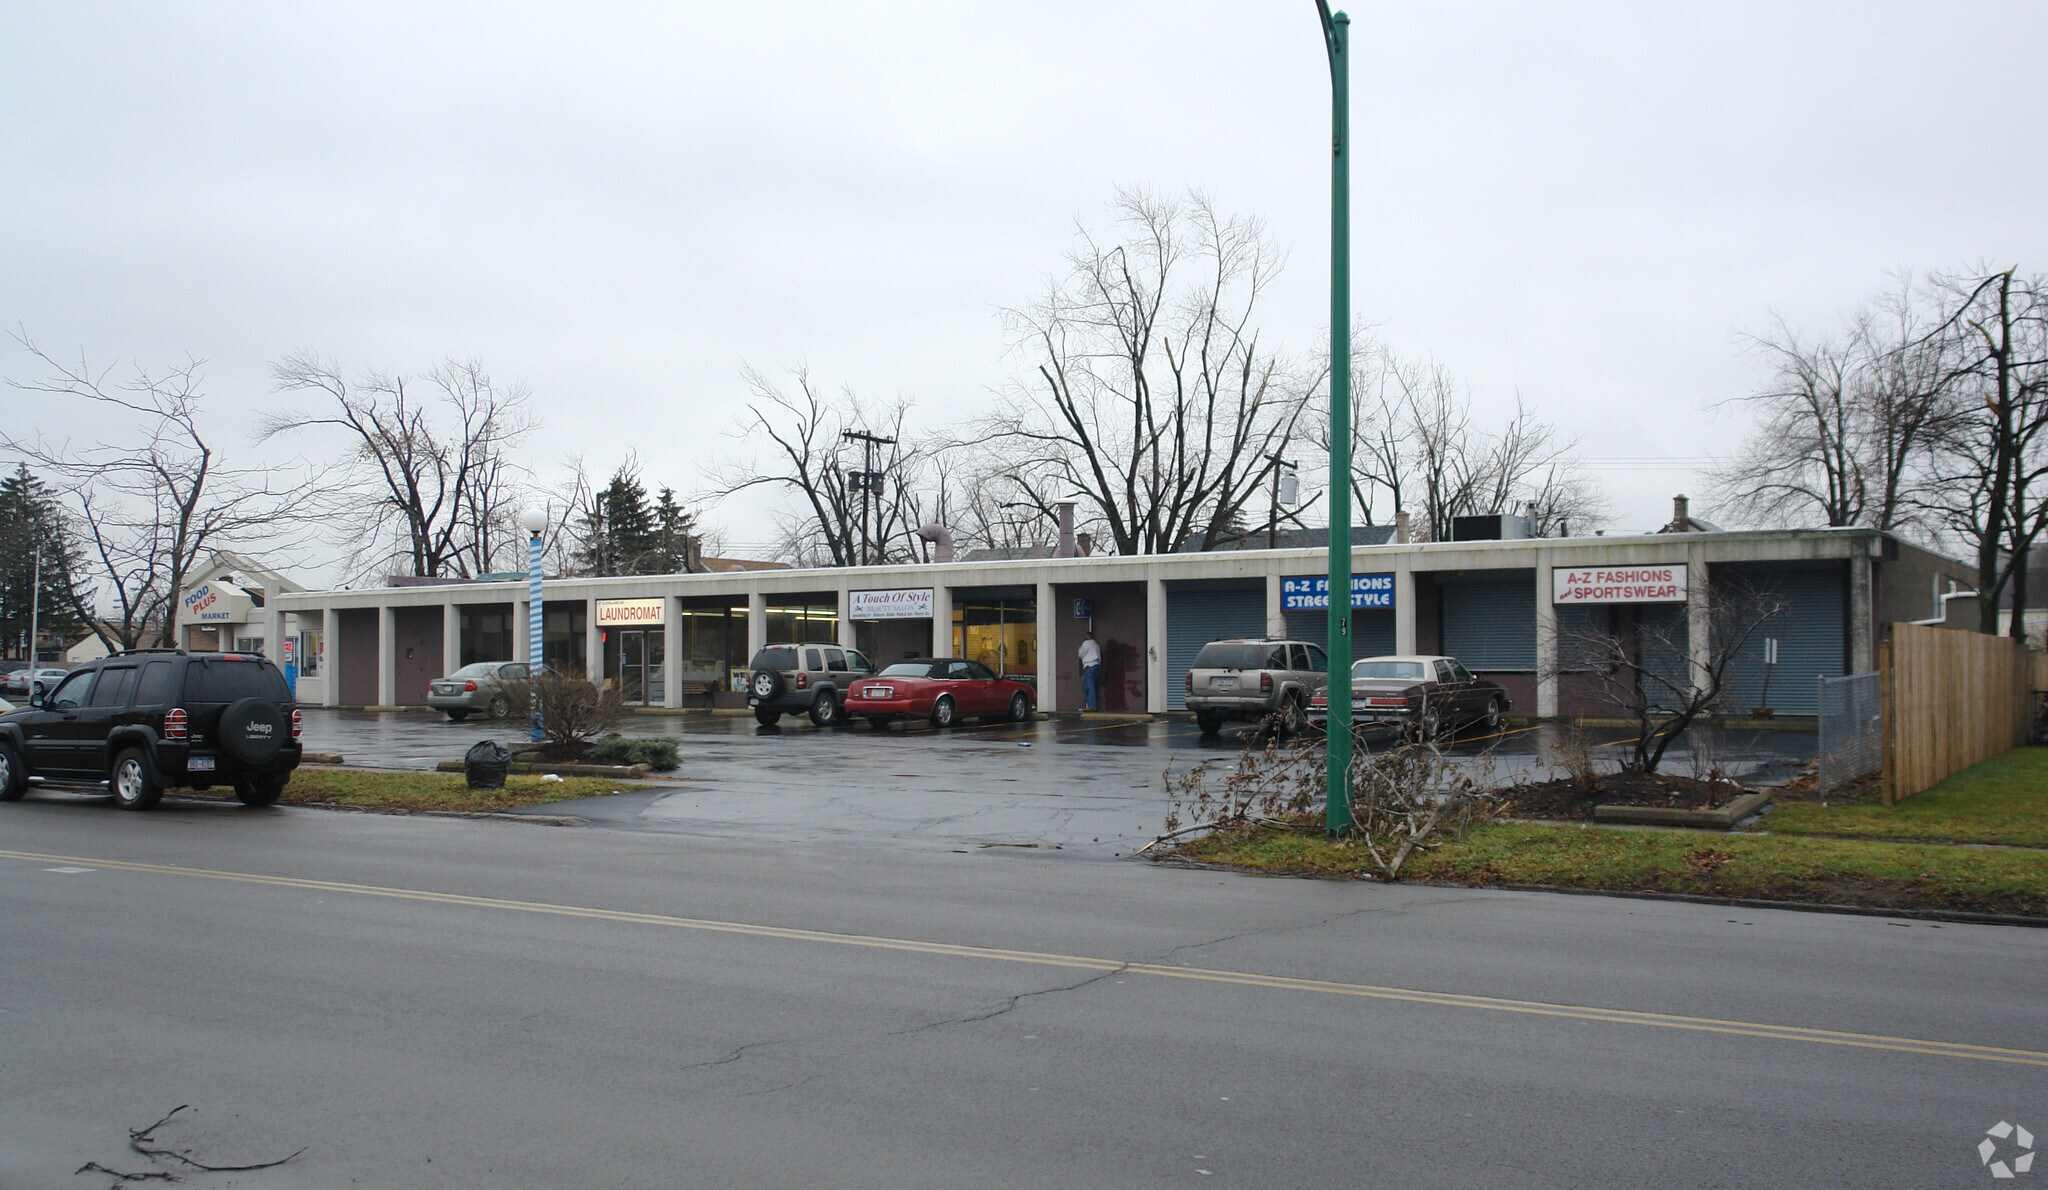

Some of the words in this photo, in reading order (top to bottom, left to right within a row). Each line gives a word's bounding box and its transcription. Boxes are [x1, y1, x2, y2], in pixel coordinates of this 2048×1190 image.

[1567, 572, 1592, 584] A-Z
[1596, 570, 1673, 583] FASHIONS
[1284, 580, 1311, 592] A-Z
[1316, 578, 1392, 592] FIONS
[185, 585, 209, 608] FOOD
[852, 594, 861, 604] A
[863, 593, 890, 604] Touch
[892, 592, 907, 603] Of
[906, 591, 931, 605] Style
[1559, 587, 1573, 600] and
[1574, 585, 1677, 599] SPORTSWEAR
[193, 592, 217, 615] PLUS
[1287, 595, 1330, 607] STREE
[201, 612, 230, 620] MARKET
[600, 606, 662, 621] LAUNDROMAT
[246, 720, 273, 734] Jeep
